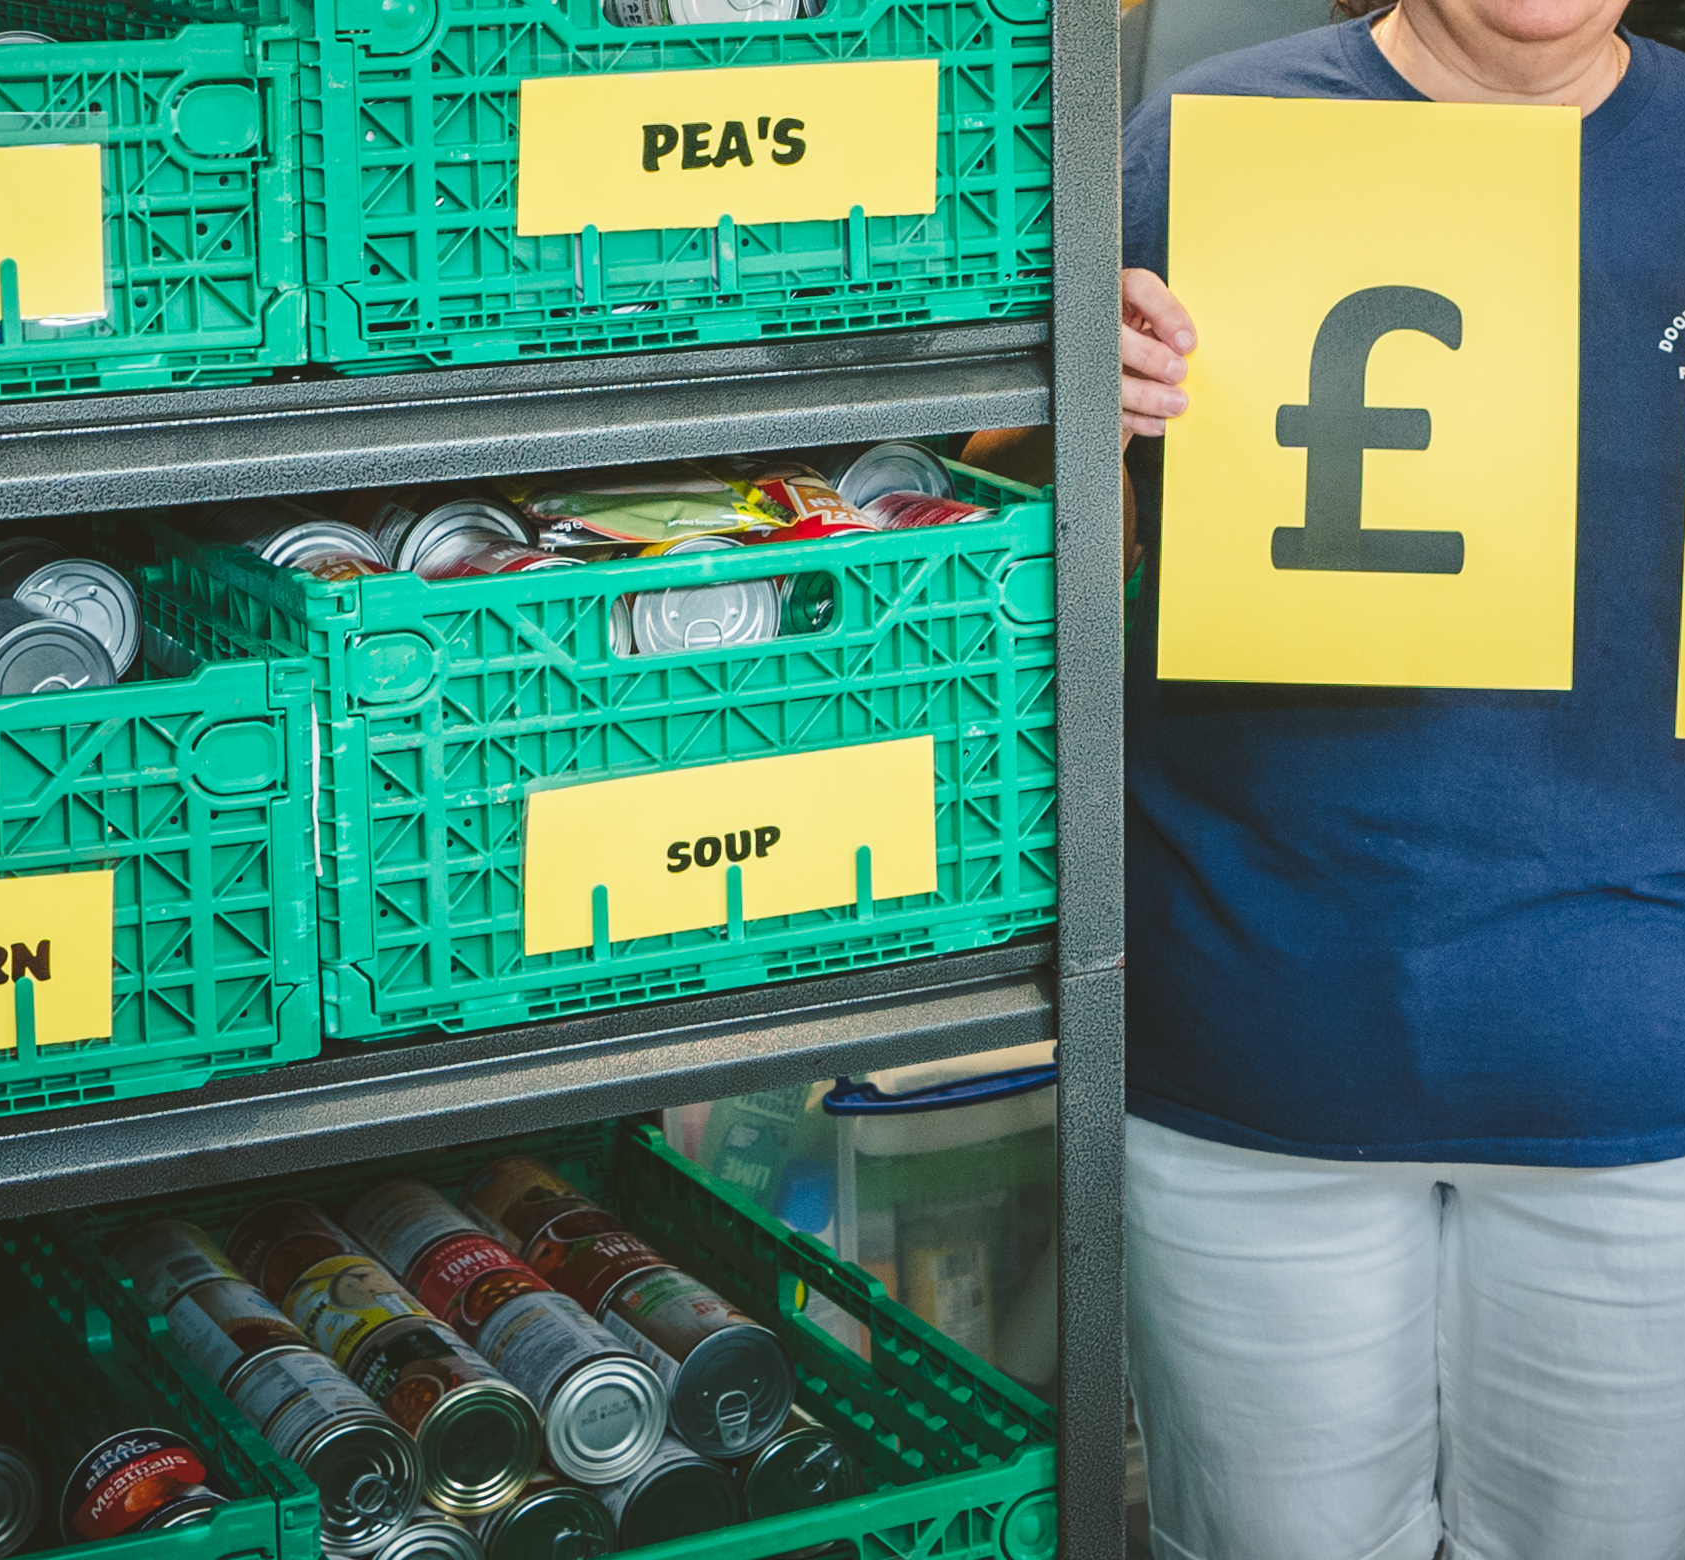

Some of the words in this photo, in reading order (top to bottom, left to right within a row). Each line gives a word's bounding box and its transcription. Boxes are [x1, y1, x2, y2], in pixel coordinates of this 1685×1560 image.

[641, 116, 808, 173] PEA'S
[1271, 285, 1465, 574] £
[666, 825, 782, 875] SOUP
[438, 1248, 510, 1283] TOMATO
[85, 1441, 162, 1490] BENTOS
[90, 1438, 139, 1471] FRAY
[90, 1455, 188, 1520] Meatballs
